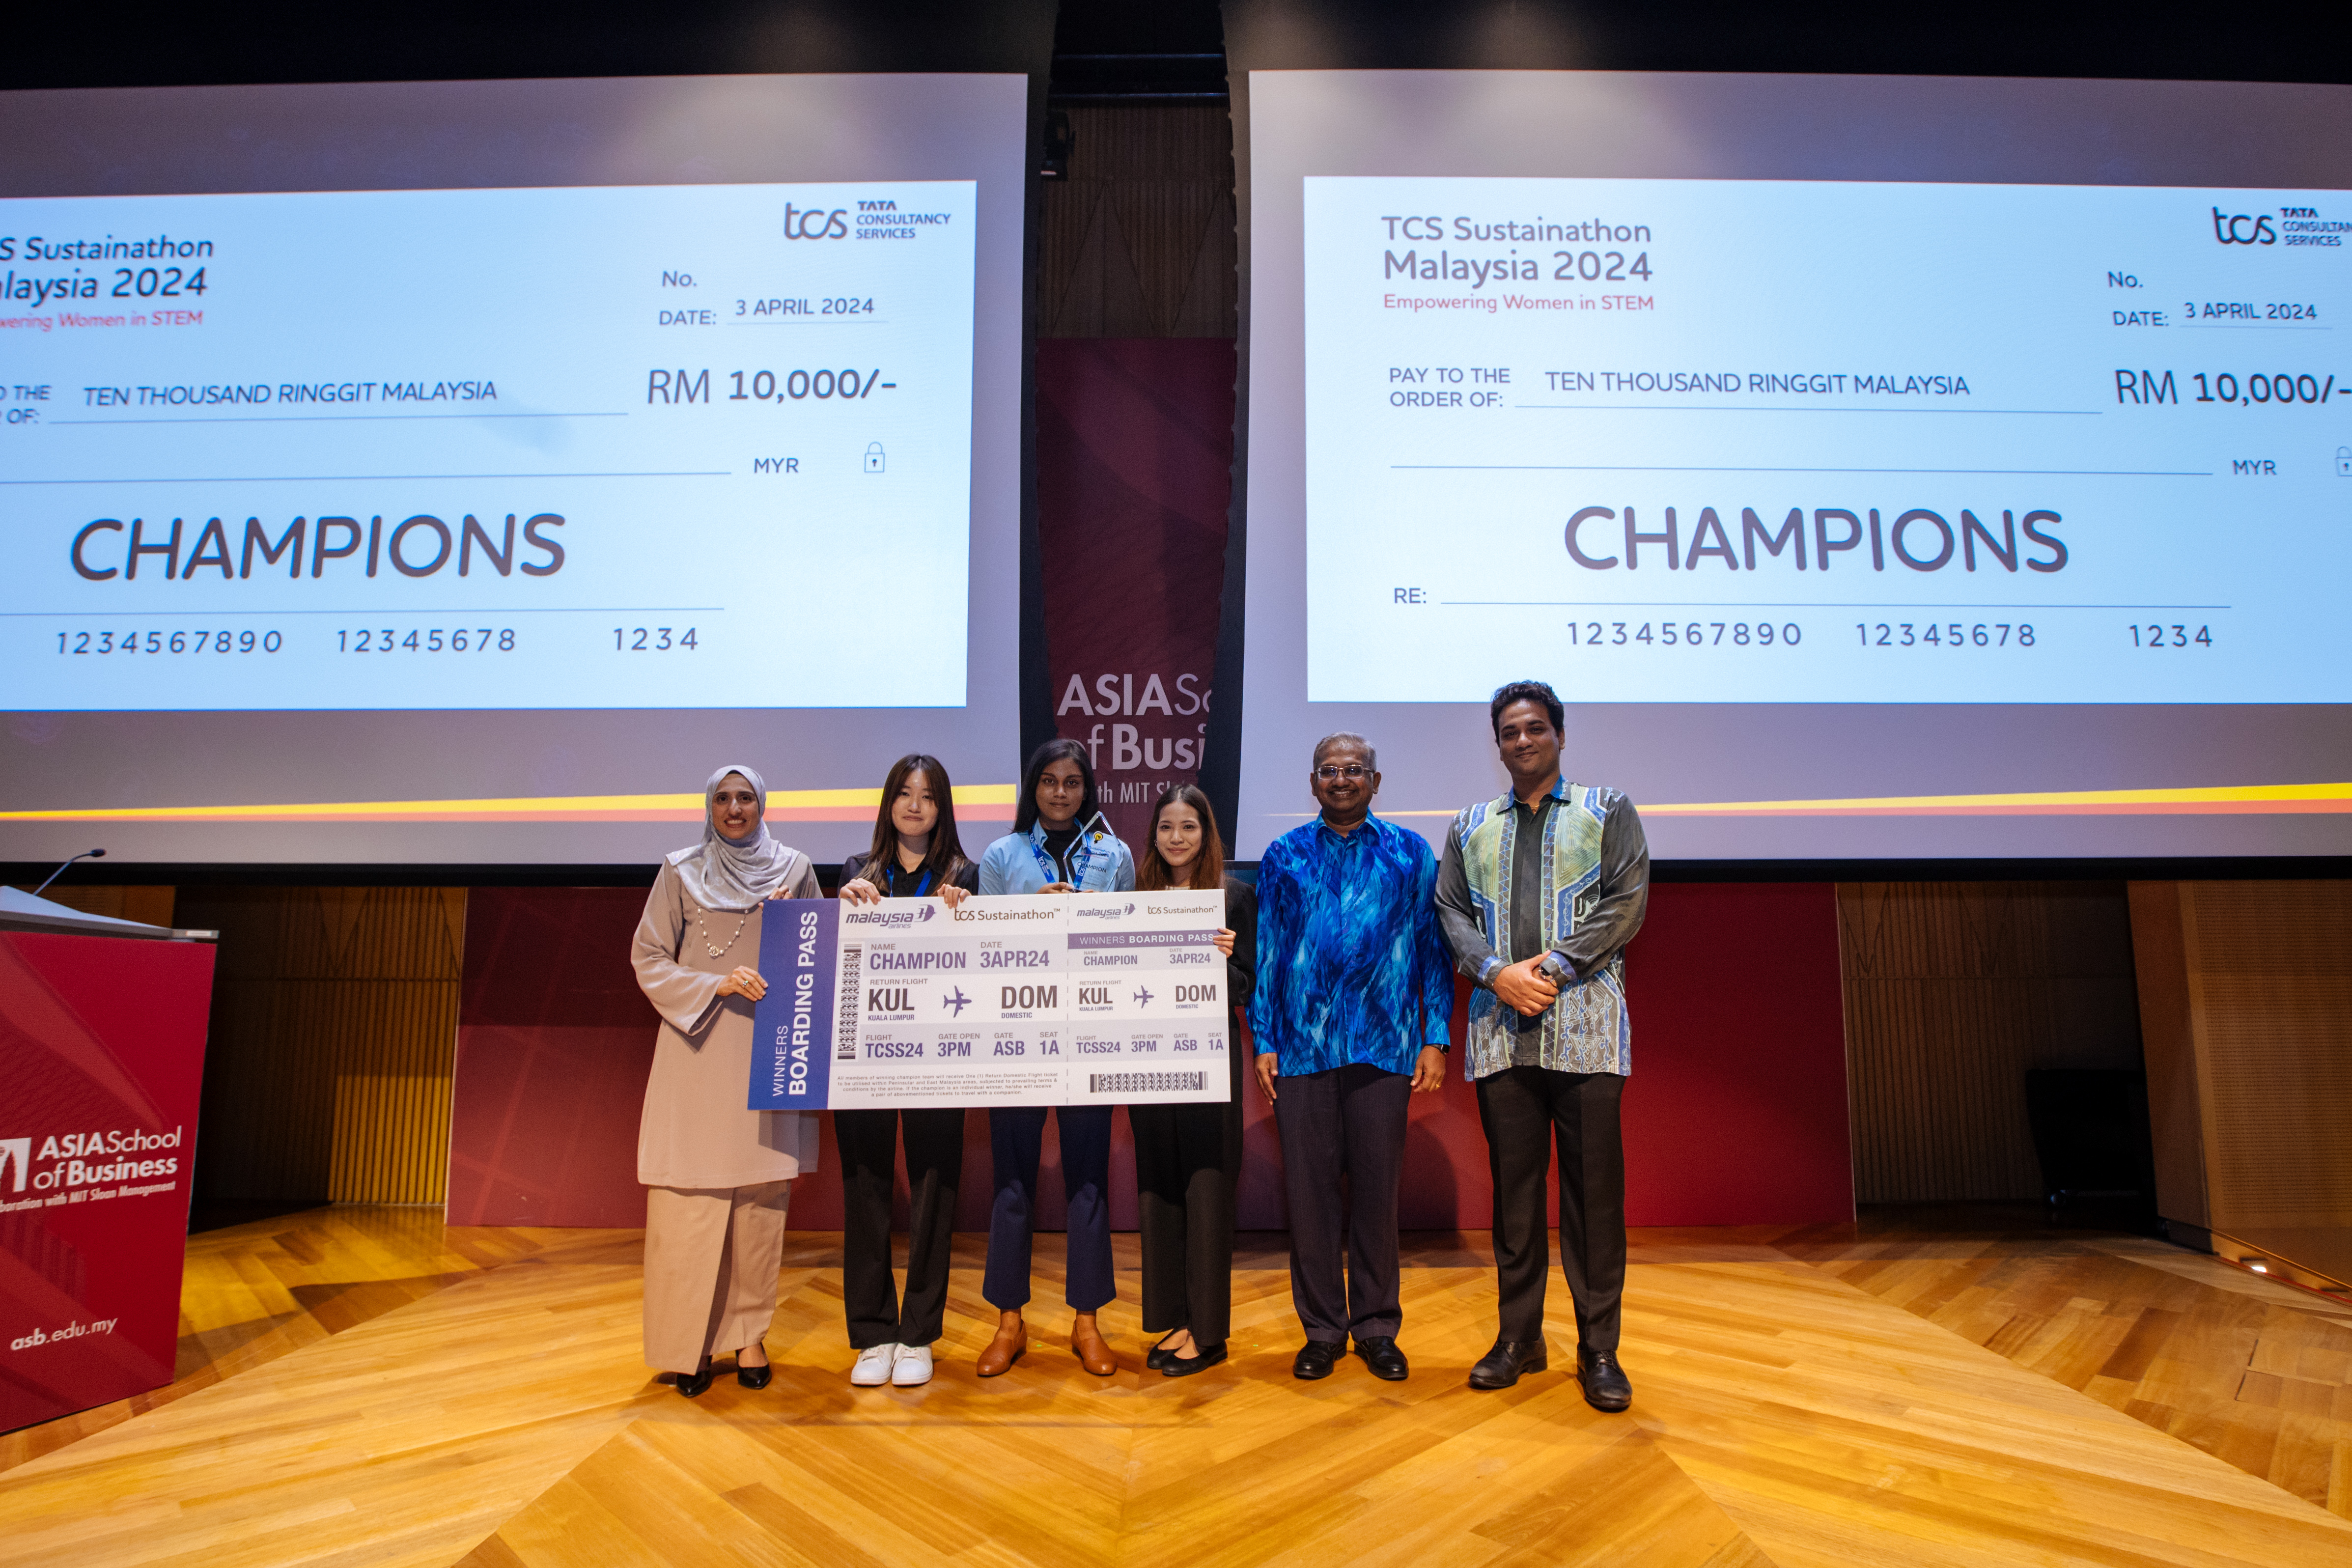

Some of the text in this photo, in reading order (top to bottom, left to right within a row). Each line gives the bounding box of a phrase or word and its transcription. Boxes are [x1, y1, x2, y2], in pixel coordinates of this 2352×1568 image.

[857, 200, 896, 211] TATA
[2280, 207, 2319, 218] TATA
[856, 213, 951, 226] CONSULTANCY
[2283, 221, 2352, 232] CONSULTAN
[856, 227, 916, 240] SERVICES
[1381, 216, 1652, 243] TCS Sustainathon
[25, 235, 213, 260] Sustainathon
[2284, 235, 2341, 246] SERVICES
[1384, 249, 1653, 289] Malaysia 2024
[0, 267, 208, 308] laysia 2024
[662, 271, 698, 288] No.
[2107, 271, 2144, 288] No.
[659, 298, 875, 326] DATE: 3 APRIL 2024
[1383, 294, 1654, 313] Empowering Women in STEM
[0, 310, 203, 332] wering Women in STEM
[2112, 302, 2317, 327] DATE: 3 APRIL 2024
[1389, 367, 1511, 383] PAY TO THE
[1545, 371, 1970, 395] TEN THOUSAND RINGGIT MALAYSIA
[14, 385, 51, 400] THE
[84, 381, 497, 405] TEN THOUSAND RINGGIT MALAYSIA
[647, 368, 897, 404] RM 10,000/-
[2115, 369, 2352, 407] RM 10,000/-
[1389, 391, 1504, 407] ORDER OF:
[7, 408, 40, 424] OF:
[754, 457, 800, 474] MYR
[2233, 459, 2277, 476] MYR
[71, 513, 565, 580] CHAMPIONS
[1565, 506, 2068, 572] CHAMPIONS
[1394, 588, 1427, 604] RE:
[57, 627, 699, 654] 1234567890 12345678 1234
[1567, 622, 2213, 647] 1234567890 12345678 1234
[1113, 723, 1205, 770] Busi
[1120, 783, 1148, 803] MIT
[1077, 862, 1107, 873] CHAMPION
[845, 910, 914, 926] malaysia
[1077, 908, 1121, 918] malaysia
[1080, 936, 1125, 945] WINNERS
[1129, 934, 1183, 943] BOARDING
[870, 950, 1050, 970] CHAMPION 3APR24
[1084, 953, 1210, 966] CHAMPION 3APR24
[789, 912, 818, 1095] BOARDING PASS
[868, 985, 1057, 1011] KUL DOM
[1079, 985, 1216, 1004] KUL DOM
[865, 1040, 1060, 1058] TCSS24 3PM ASB 1A
[1076, 1039, 1224, 1053] TCSS24 3PM ASB 1A
[772, 1026, 788, 1096] WINNERS
[33, 1156, 178, 1189] of Business
[45, 1192, 67, 1206] with
[68, 1189, 89, 1204] MIT
[118, 1180, 176, 1197] Management
[10, 1318, 118, 1350] asb.edu.my
